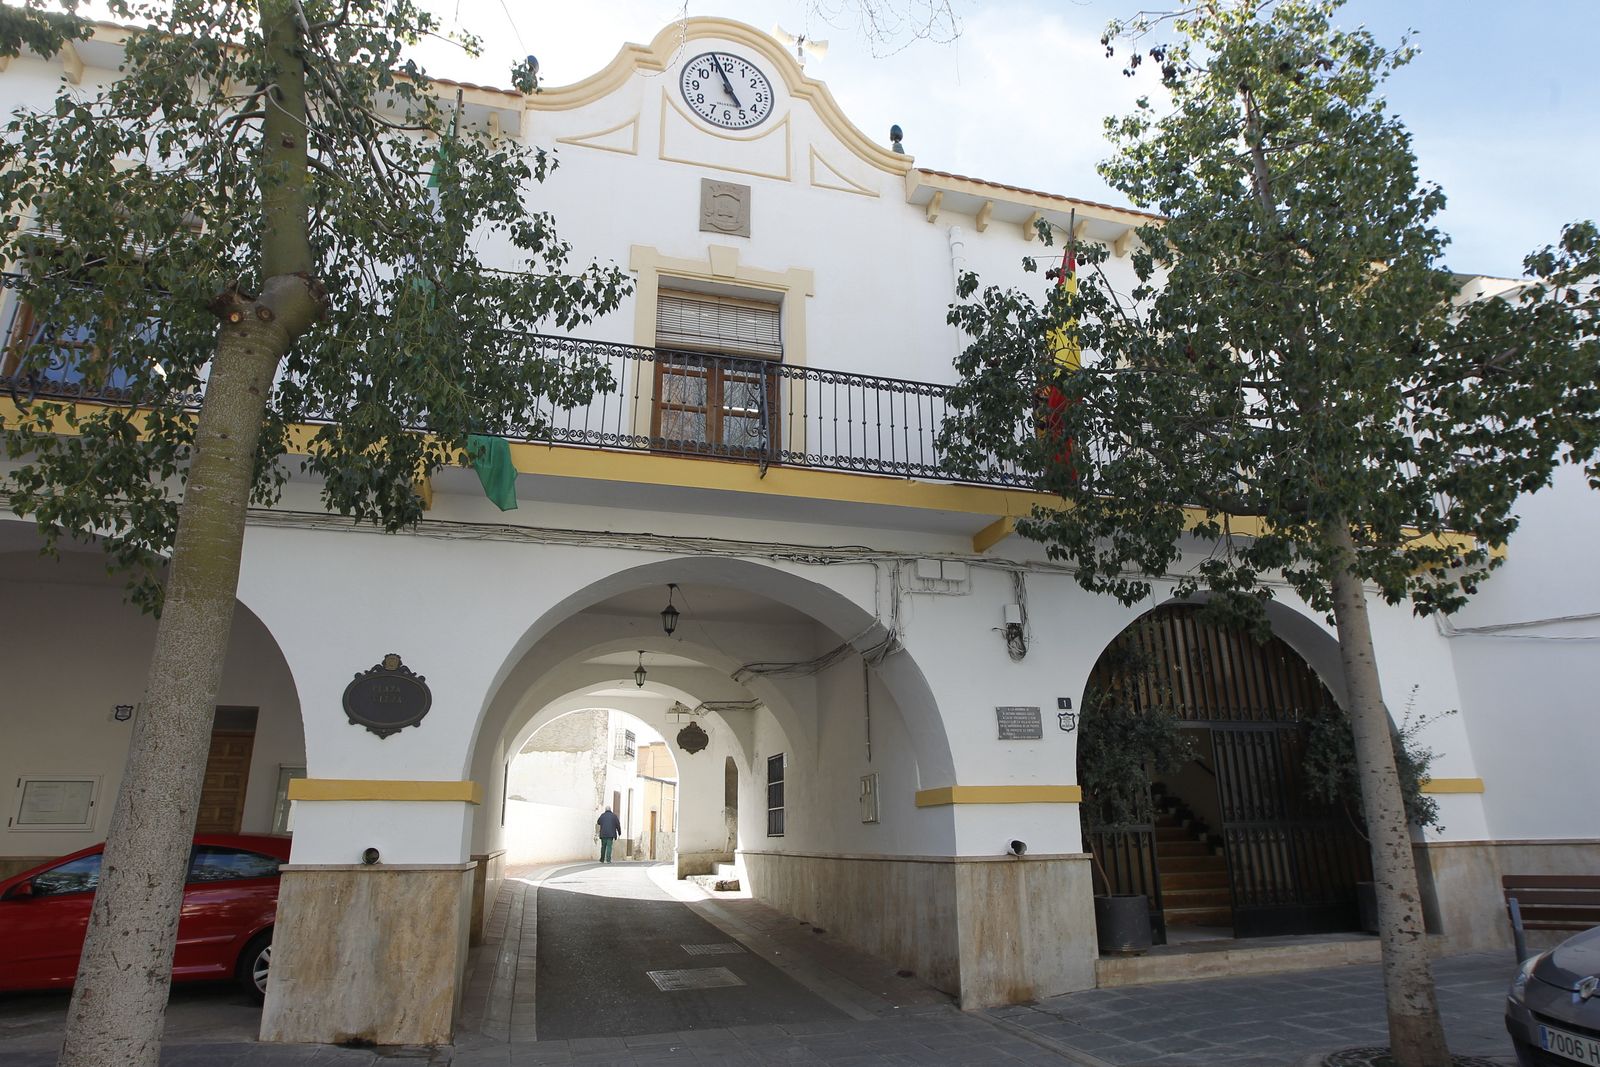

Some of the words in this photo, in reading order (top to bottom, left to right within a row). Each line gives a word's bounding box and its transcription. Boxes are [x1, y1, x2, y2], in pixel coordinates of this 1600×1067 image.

[709, 62, 719, 73] 11
[723, 62, 734, 74] 12
[697, 68, 709, 79] 10
[740, 69, 745, 78] 1
[692, 80, 699, 90] 9
[750, 79, 757, 89] 2
[696, 93, 704, 104] 8
[755, 92, 762, 103] 3
[709, 103, 717, 114] 7
[750, 104, 757, 114] 4
[723, 110, 731, 120] 6
[738, 109, 746, 120] 5
[1548, 1031, 1584, 1059] 7006
[1588, 1043, 1600, 1065] H
